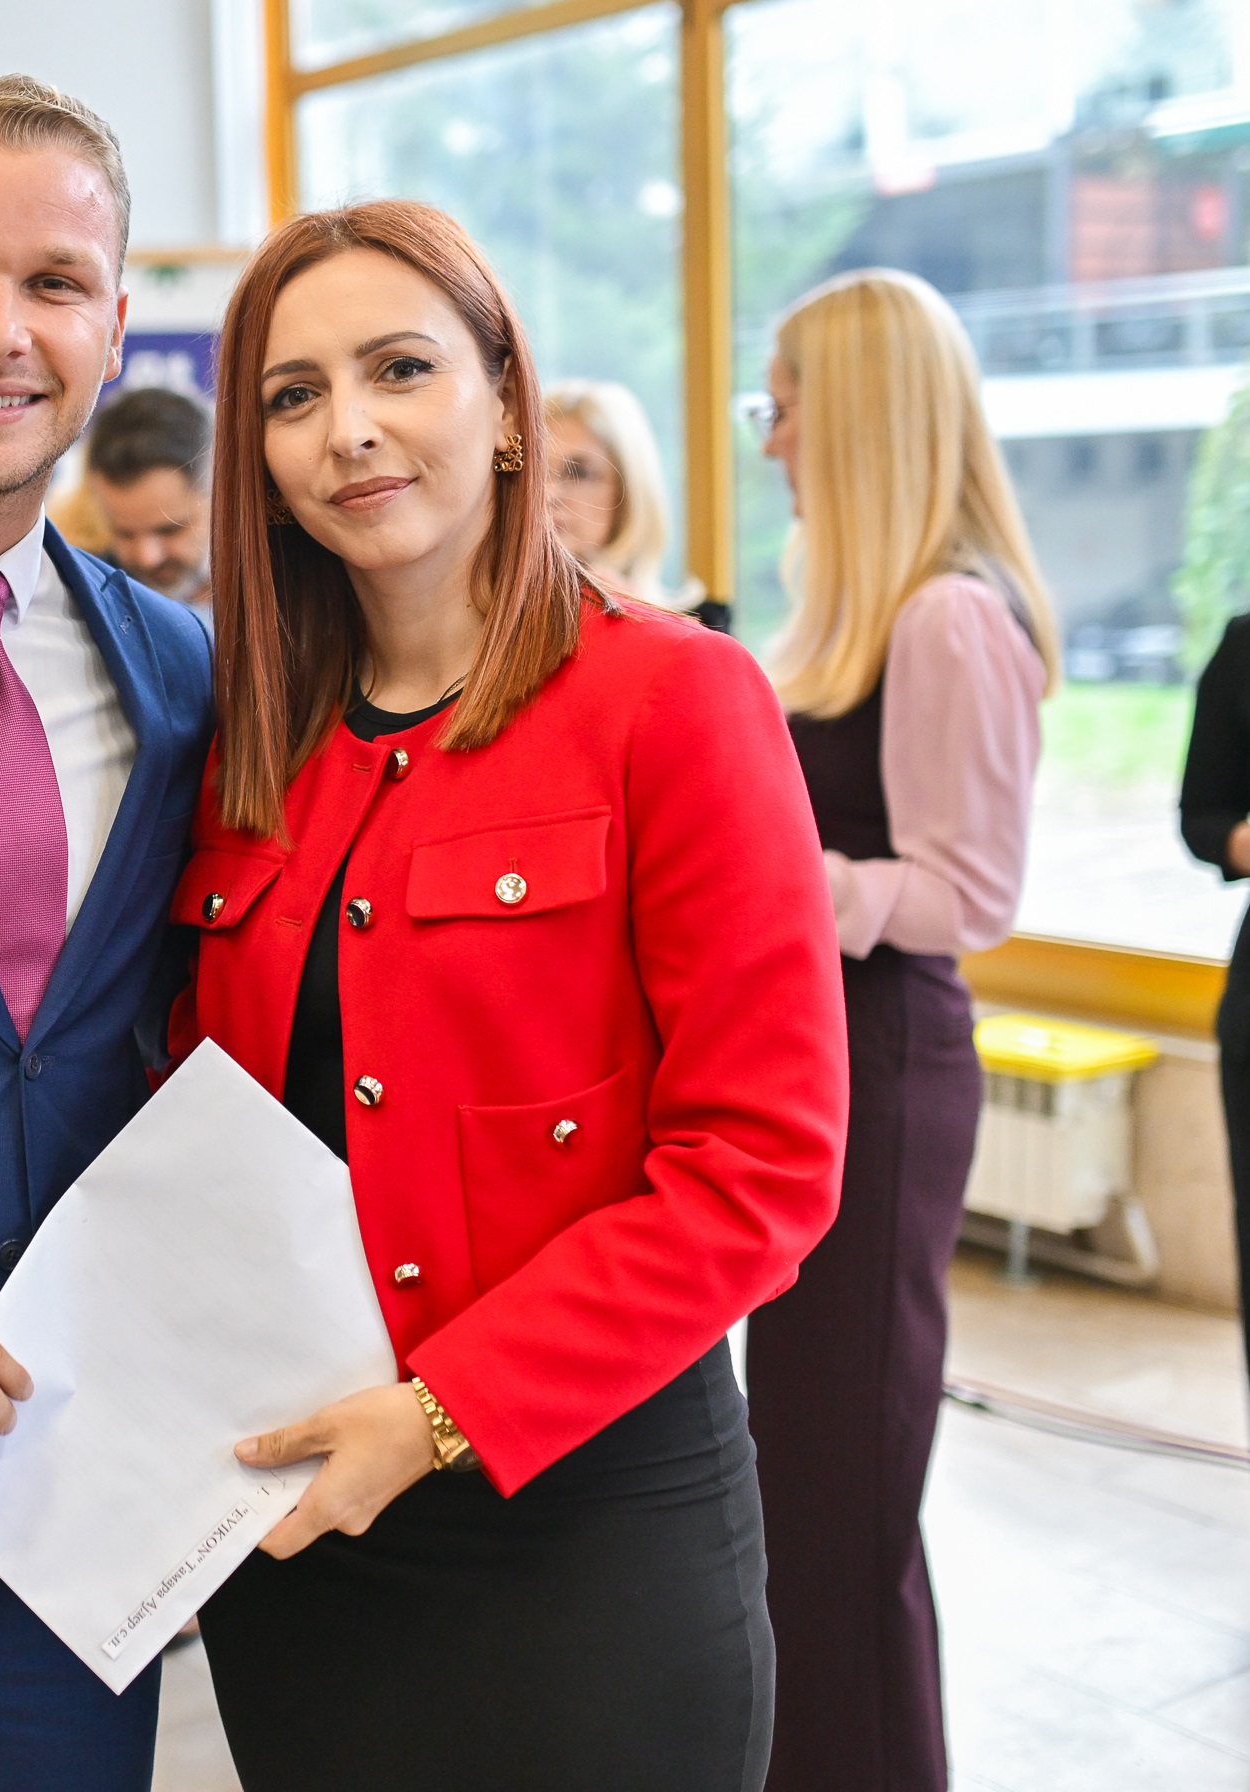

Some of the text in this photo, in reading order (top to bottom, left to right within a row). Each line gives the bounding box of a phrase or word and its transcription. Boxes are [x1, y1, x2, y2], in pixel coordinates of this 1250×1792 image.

[197, 1508, 249, 1563] "EVIKON"
[156, 1561, 197, 1599] Тамара
[127, 1597, 158, 1630] Ајдер
